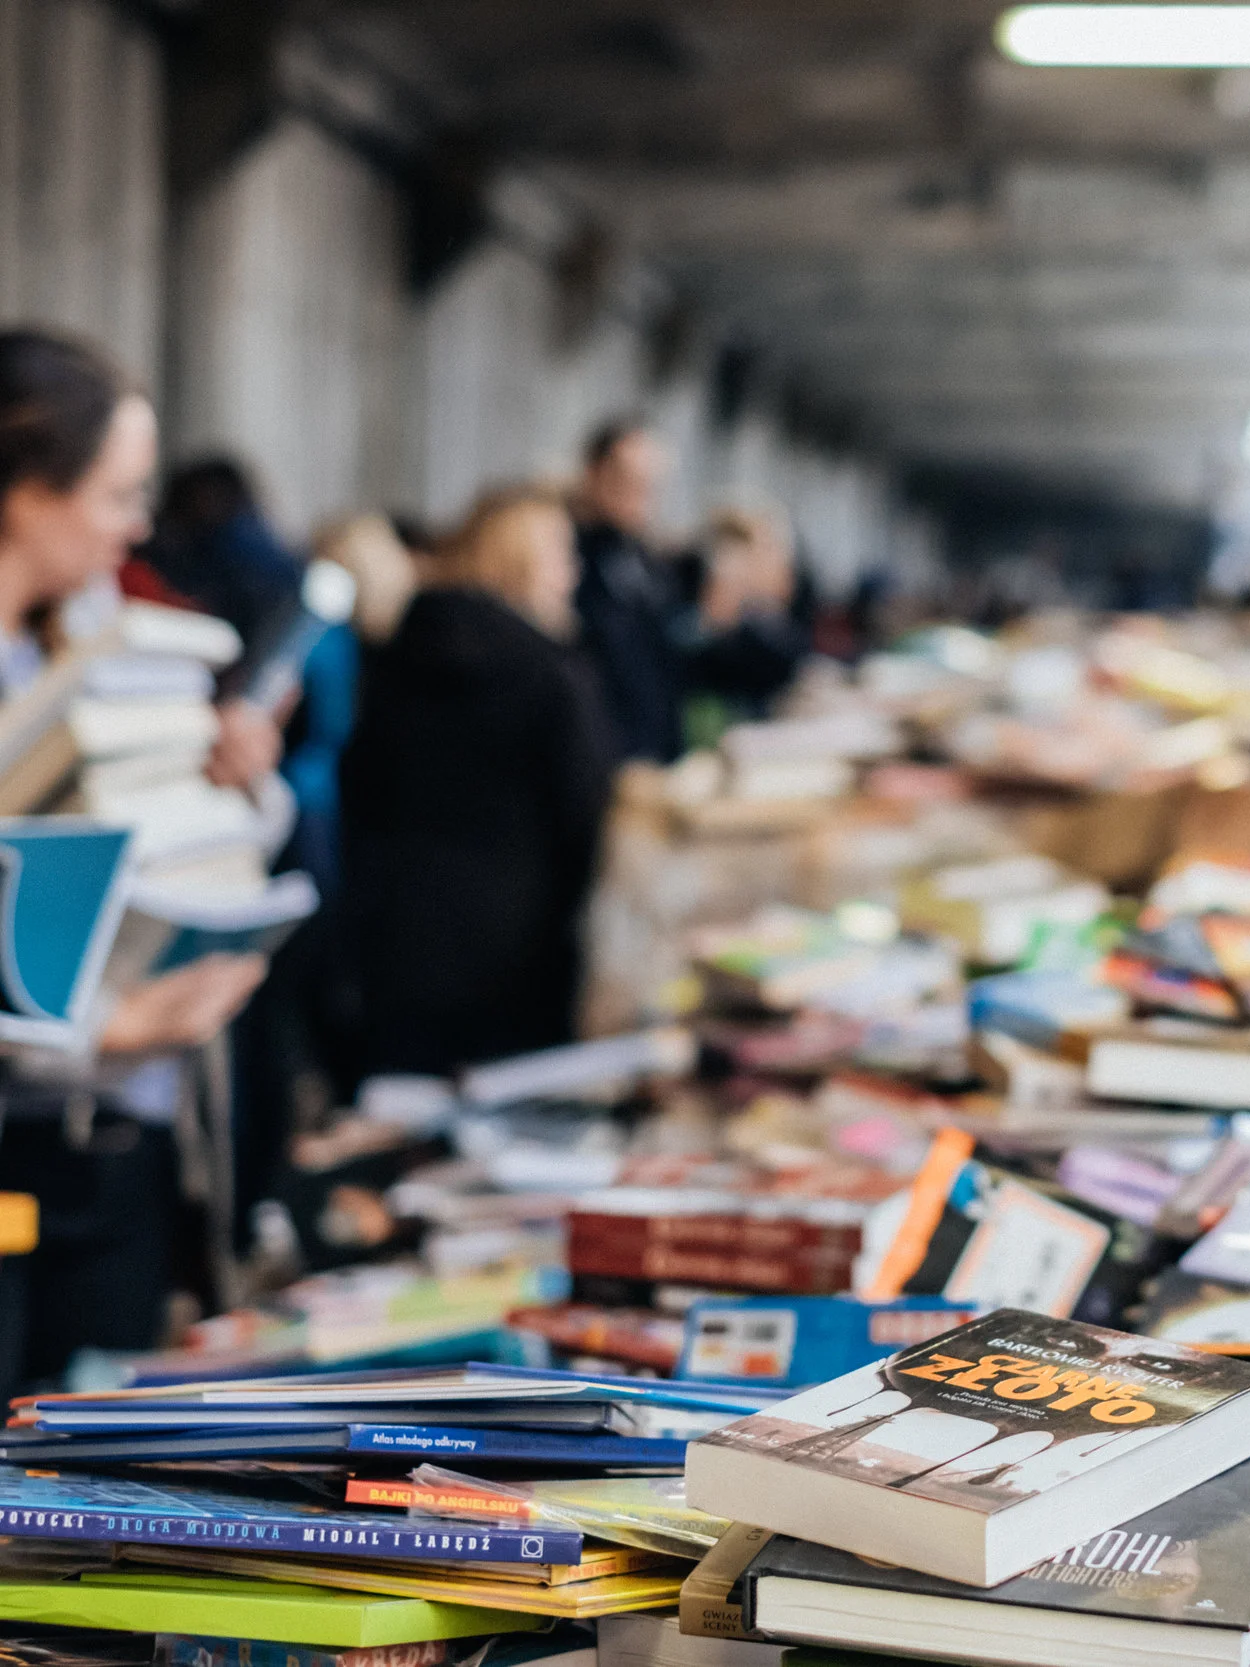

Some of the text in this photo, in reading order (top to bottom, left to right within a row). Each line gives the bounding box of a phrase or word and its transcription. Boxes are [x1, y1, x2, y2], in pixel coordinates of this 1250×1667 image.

[979, 1354, 1147, 1400] CZARNE
[987, 1338, 1184, 1390] BARTŁOMIEJ RYCHTER
[899, 1353, 1156, 1424] ZŁOTO
[372, 1432, 394, 1445] Atlas
[434, 1436, 476, 1450] odkrywcy
[369, 1489, 519, 1513] BAJKI PO ANGIELSKU
[107, 1517, 170, 1533] DROGA
[186, 1520, 280, 1539] MIODOWA
[303, 1528, 379, 1546] MIODAL
[394, 1534, 400, 1546] I
[415, 1534, 490, 1551] ŁABĘDŹ
[1052, 1529, 1172, 1575] ROHL
[1045, 1564, 1140, 1588] FIGHTERS
[703, 1610, 740, 1621] GWIAZ
[703, 1620, 738, 1633] SCENY
